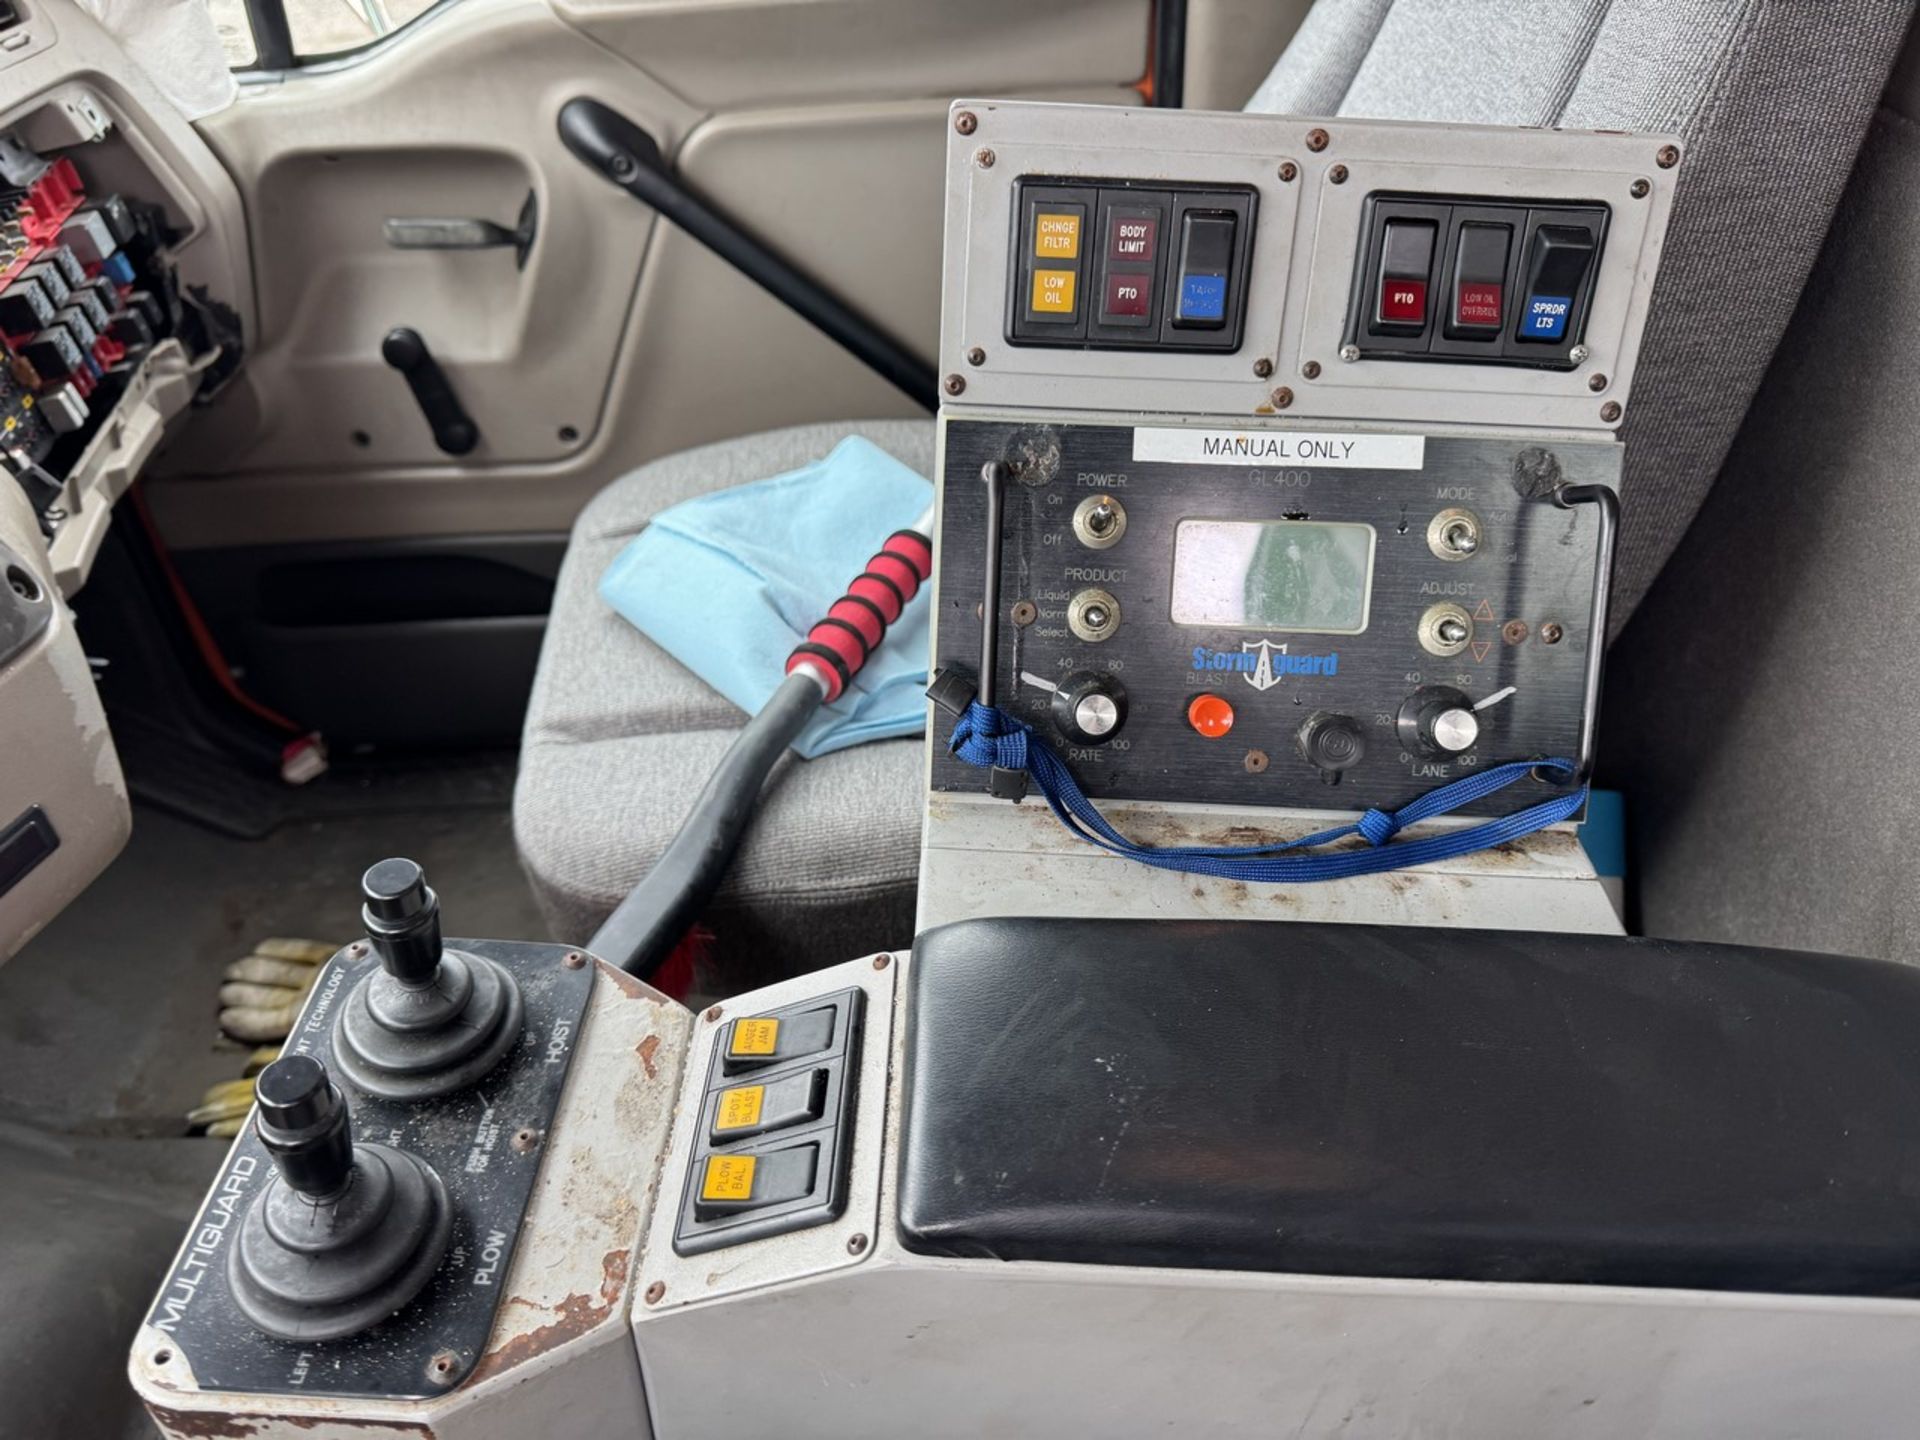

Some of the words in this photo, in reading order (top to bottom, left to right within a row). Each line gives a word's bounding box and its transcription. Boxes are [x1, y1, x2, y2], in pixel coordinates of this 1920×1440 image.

[1041, 221, 1075, 234] CHNGE
[1120, 226, 1147, 238] BODY
[1044, 236, 1071, 248] FILTR
[1118, 241, 1146, 253] LIMIT
[1044, 277, 1065, 288] LOW
[1045, 292, 1062, 304] OIL
[1118, 287, 1137, 299] PTO
[1394, 293, 1414, 304] PTO
[1532, 302, 1566, 315] SPRDR
[1536, 317, 1554, 328] LTS
[1203, 437, 1291, 457] MANUAL
[1297, 440, 1355, 459] ONLY
[1077, 473, 1128, 487] POWER
[1248, 469, 1312, 488] GL400
[1437, 487, 1476, 500] MODE
[1048, 495, 1063, 506] On
[1043, 534, 1062, 546] Off
[1064, 567, 1128, 582] PRODUCT
[1037, 589, 1070, 602] Liquid
[1420, 582, 1476, 596] ADJUST
[1035, 626, 1069, 638] Select
[1057, 657, 1073, 668] 40
[1186, 671, 1230, 685] BLAST
[1404, 672, 1421, 683] 40
[1456, 674, 1473, 685] 60
[1031, 699, 1046, 710] 20
[1376, 714, 1392, 725] 20
[1068, 748, 1104, 762] RATE
[1457, 755, 1478, 766] 100
[1411, 765, 1450, 778] LANE
[304, 966, 346, 1033] TECHNOLOGY
[544, 1017, 572, 1063] HOIST
[741, 1091, 757, 1124] BLAST
[716, 1161, 732, 1192] PLOW
[155, 1155, 257, 1332] MULTIGUARD
[473, 1229, 506, 1285] PLOW
[288, 1351, 314, 1384] LEFT
